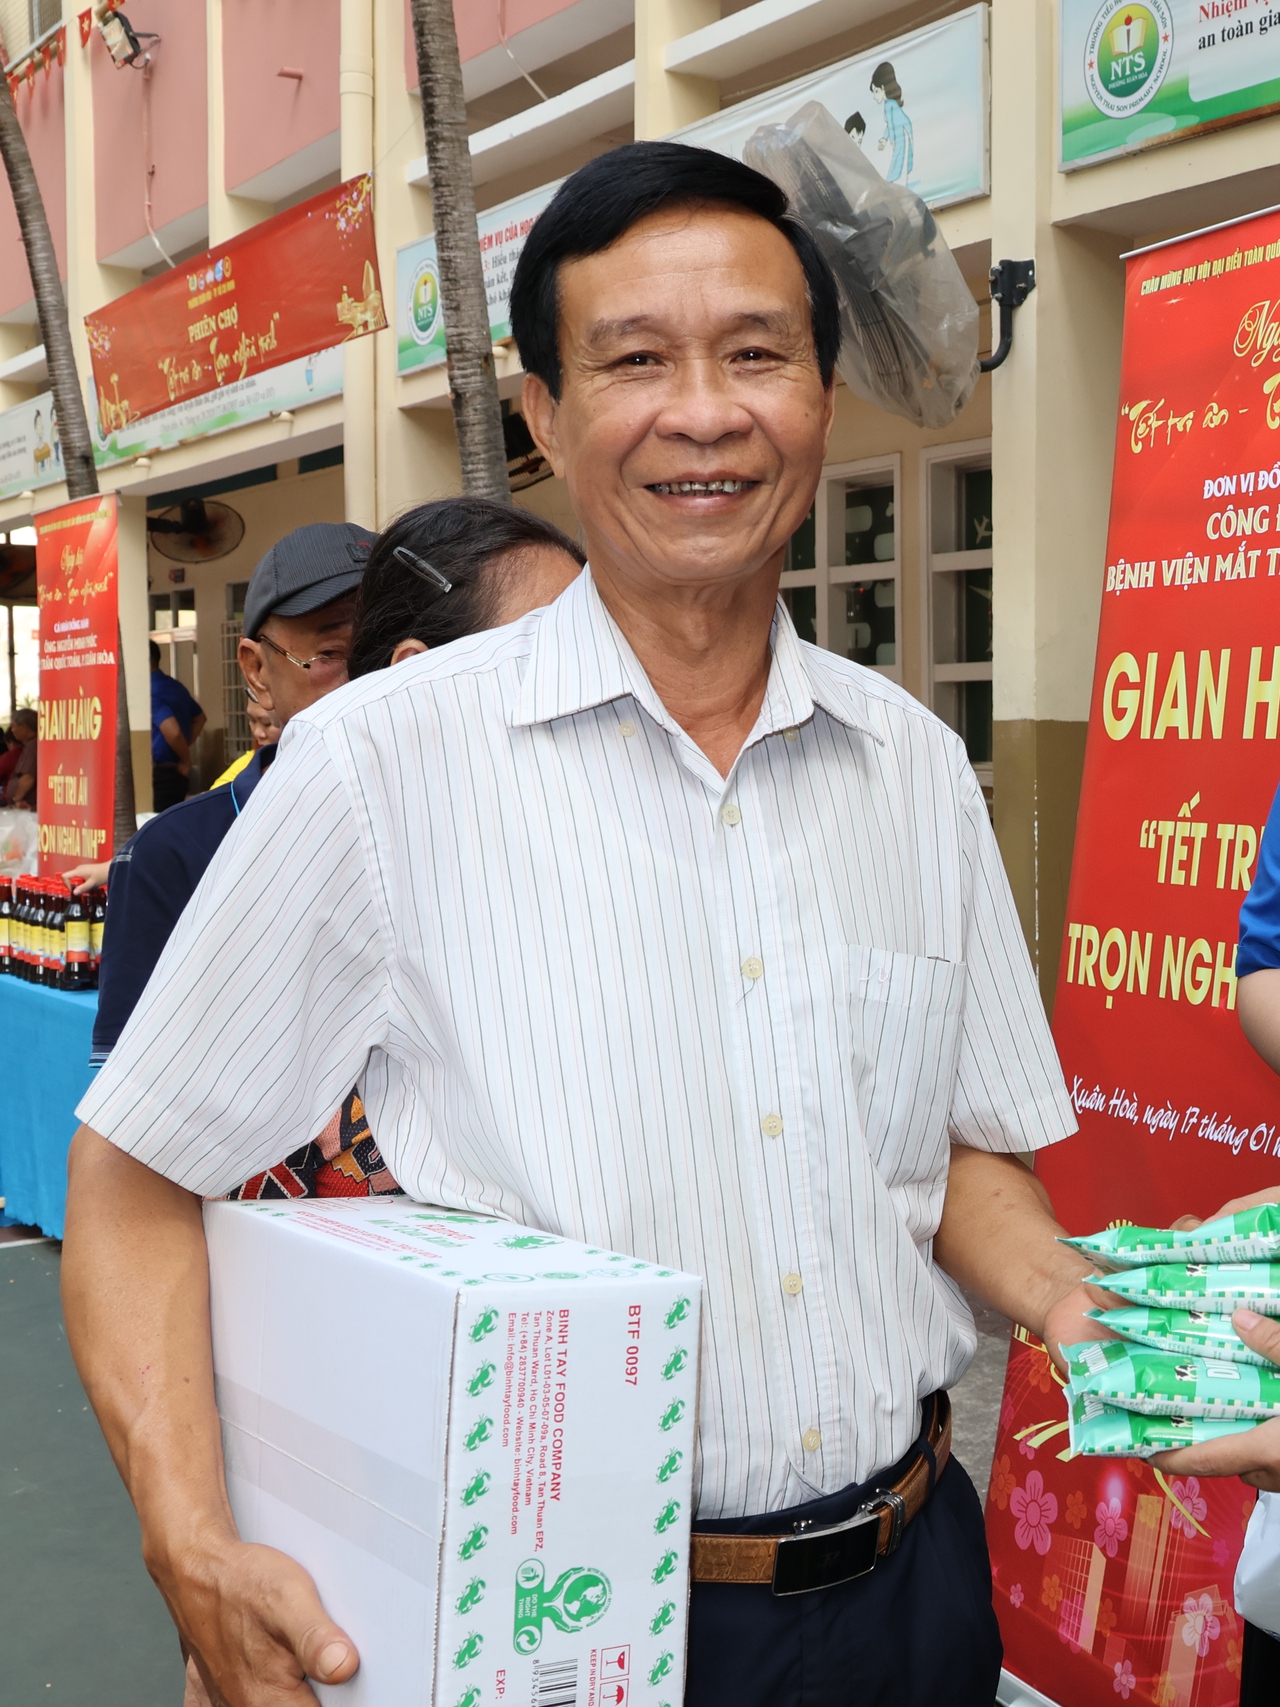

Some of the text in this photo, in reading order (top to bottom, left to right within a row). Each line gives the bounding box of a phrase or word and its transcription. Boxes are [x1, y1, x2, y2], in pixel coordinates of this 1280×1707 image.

[1198, 33, 1216, 50] an
[1221, 20, 1254, 42] toàn
[1110, 51, 1146, 80] NTS
[1153, 48, 1168, 85] SCHOOL
[1140, 275, 1160, 296] CHÀO
[1159, 269, 1182, 290] MỪNG
[1183, 265, 1197, 286] ĐẠI
[1197, 260, 1212, 282] HỘI
[1212, 257, 1225, 279] ĐẠI
[1225, 247, 1243, 272] BIỂU
[1243, 245, 1265, 267] TOÀN
[187, 302, 238, 343] PHIÊN CHỢ
[417, 304, 433, 320] NTS
[1202, 402, 1230, 429] ân
[1203, 476, 1237, 499] ĐƠN
[1239, 472, 1256, 497] VỊ
[1206, 504, 1269, 541] CÔNG
[1106, 558, 1156, 596] BỆNH
[1161, 551, 1208, 591] VIỆN
[1213, 540, 1261, 582] MẮT
[1102, 648, 1231, 741] GIAN
[37, 685, 102, 741] GIAN HÀNG
[1139, 790, 1267, 892] “TẾT TR
[1066, 922, 1239, 1011] TRỌN NGH
[1068, 1074, 1106, 1115] Xuân
[1108, 1087, 1139, 1126] Hoà,
[1142, 1100, 1181, 1141] ngày
[1180, 1106, 1200, 1134] 17
[1198, 1111, 1249, 1156] tháng
[1249, 1122, 1276, 1155] 01
[520, 1312, 529, 1328] Tel:
[546, 1310, 554, 1333] Zone
[519, 1330, 528, 1353] (+84)
[544, 1335, 553, 1345] A,
[544, 1347, 552, 1363] Lot
[625, 1304, 641, 1386] BTF 0097
[502, 1312, 516, 1447] Email: info@binhtayfood.com
[517, 1355, 527, 1408] 2837700940
[525, 1311, 542, 1506] Tan Thuan Ward, Ho Chi Minh City, Vietnam
[550, 1309, 569, 1501] BINH TAY FOOD COMPANY
[514, 1416, 524, 1456] Website:
[539, 1445, 548, 1469] Road
[537, 1471, 546, 1480] 8,
[537, 1481, 546, 1498] Tan
[511, 1458, 522, 1535] binhtayfood.com
[536, 1500, 545, 1529] Thuan
[534, 1531, 544, 1552] EPZ,
[517, 1597, 525, 1619] THING
[530, 1593, 539, 1618] DO THE
[495, 1669, 506, 1700] EXP:
[589, 1668, 596, 1676] IN
[587, 1692, 595, 1707] AND
